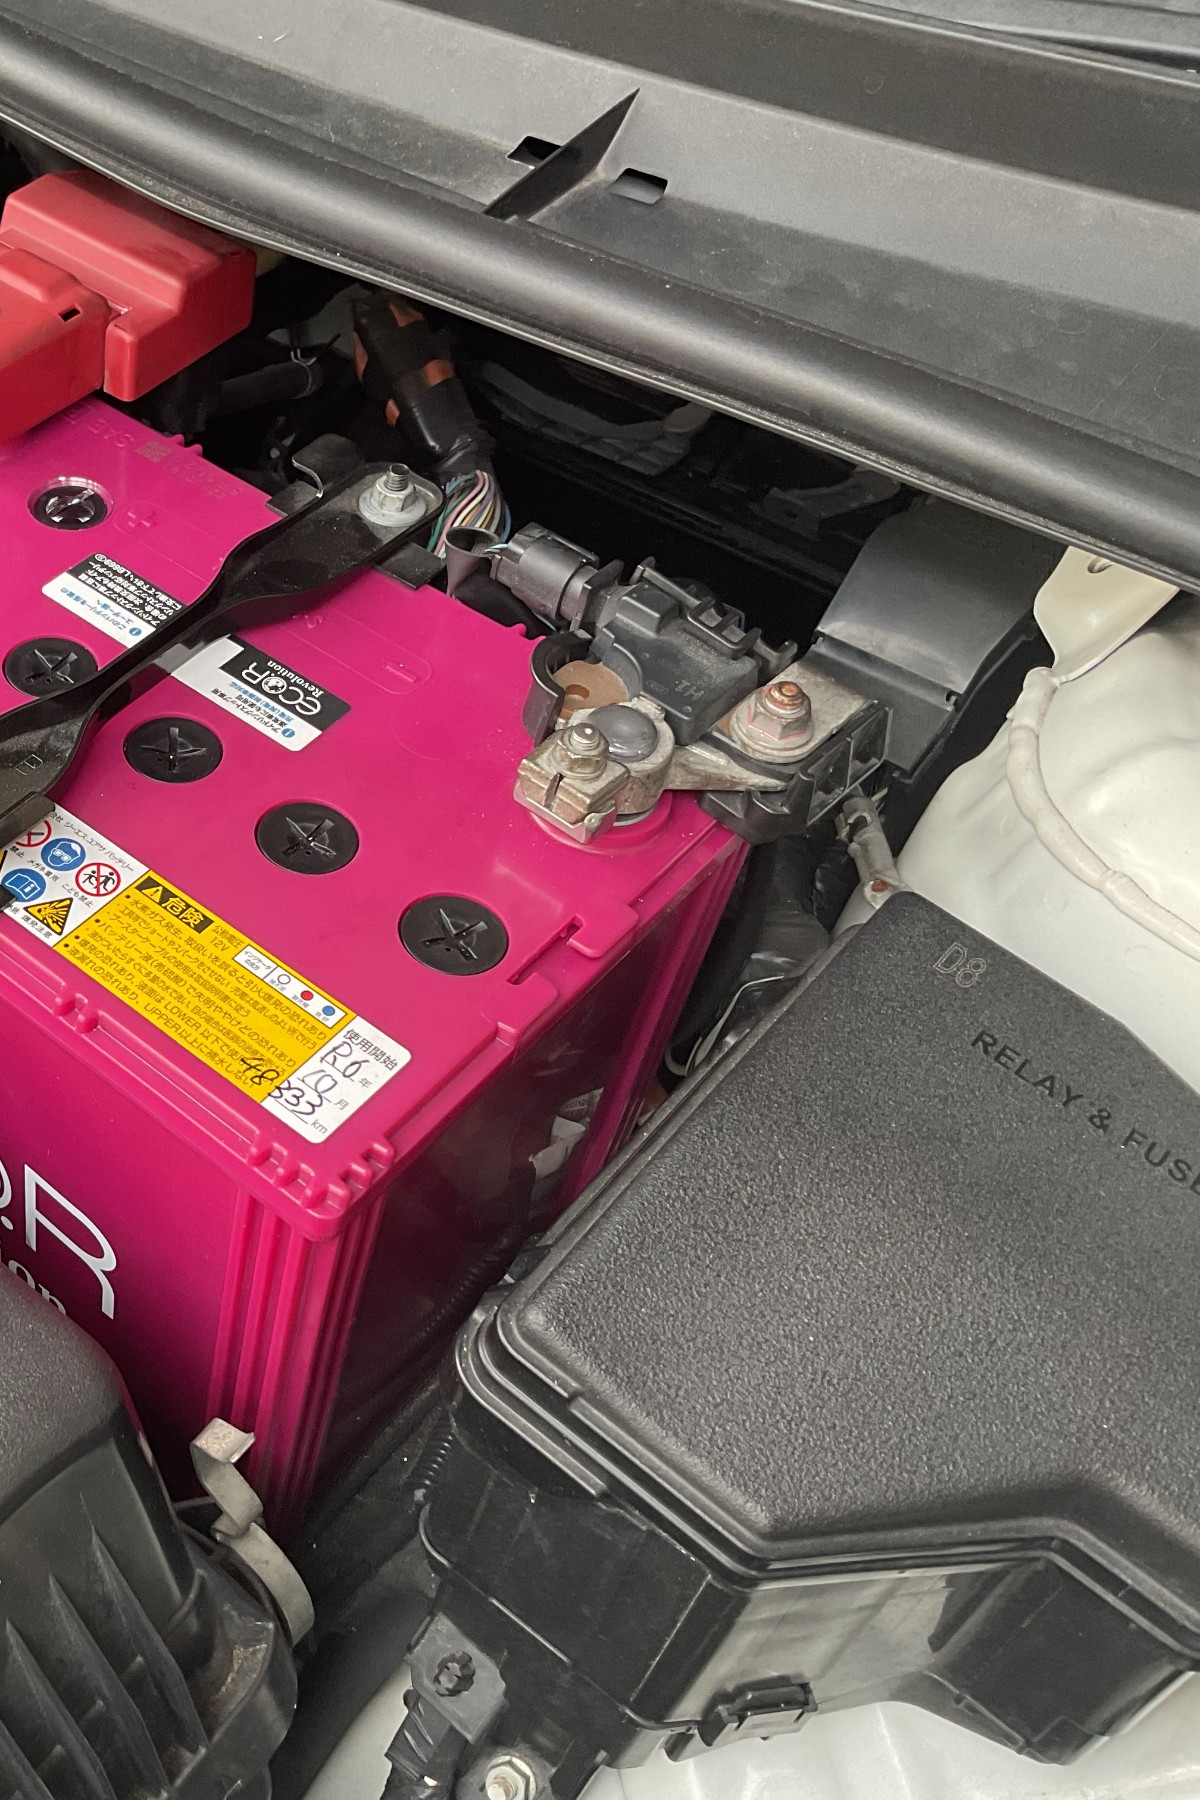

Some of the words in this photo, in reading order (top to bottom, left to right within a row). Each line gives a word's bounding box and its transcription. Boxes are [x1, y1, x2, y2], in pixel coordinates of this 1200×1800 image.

[267, 660, 324, 698] Revolution
[160, 894, 207, 929] 危険
[208, 936, 230, 952] 12V
[343, 1029, 398, 1071] 使用開始
[971, 1030, 1084, 1107] RELAY
[1088, 1107, 1112, 1134] &
[333, 1098, 349, 1111] 月
[310, 1119, 328, 1135] km
